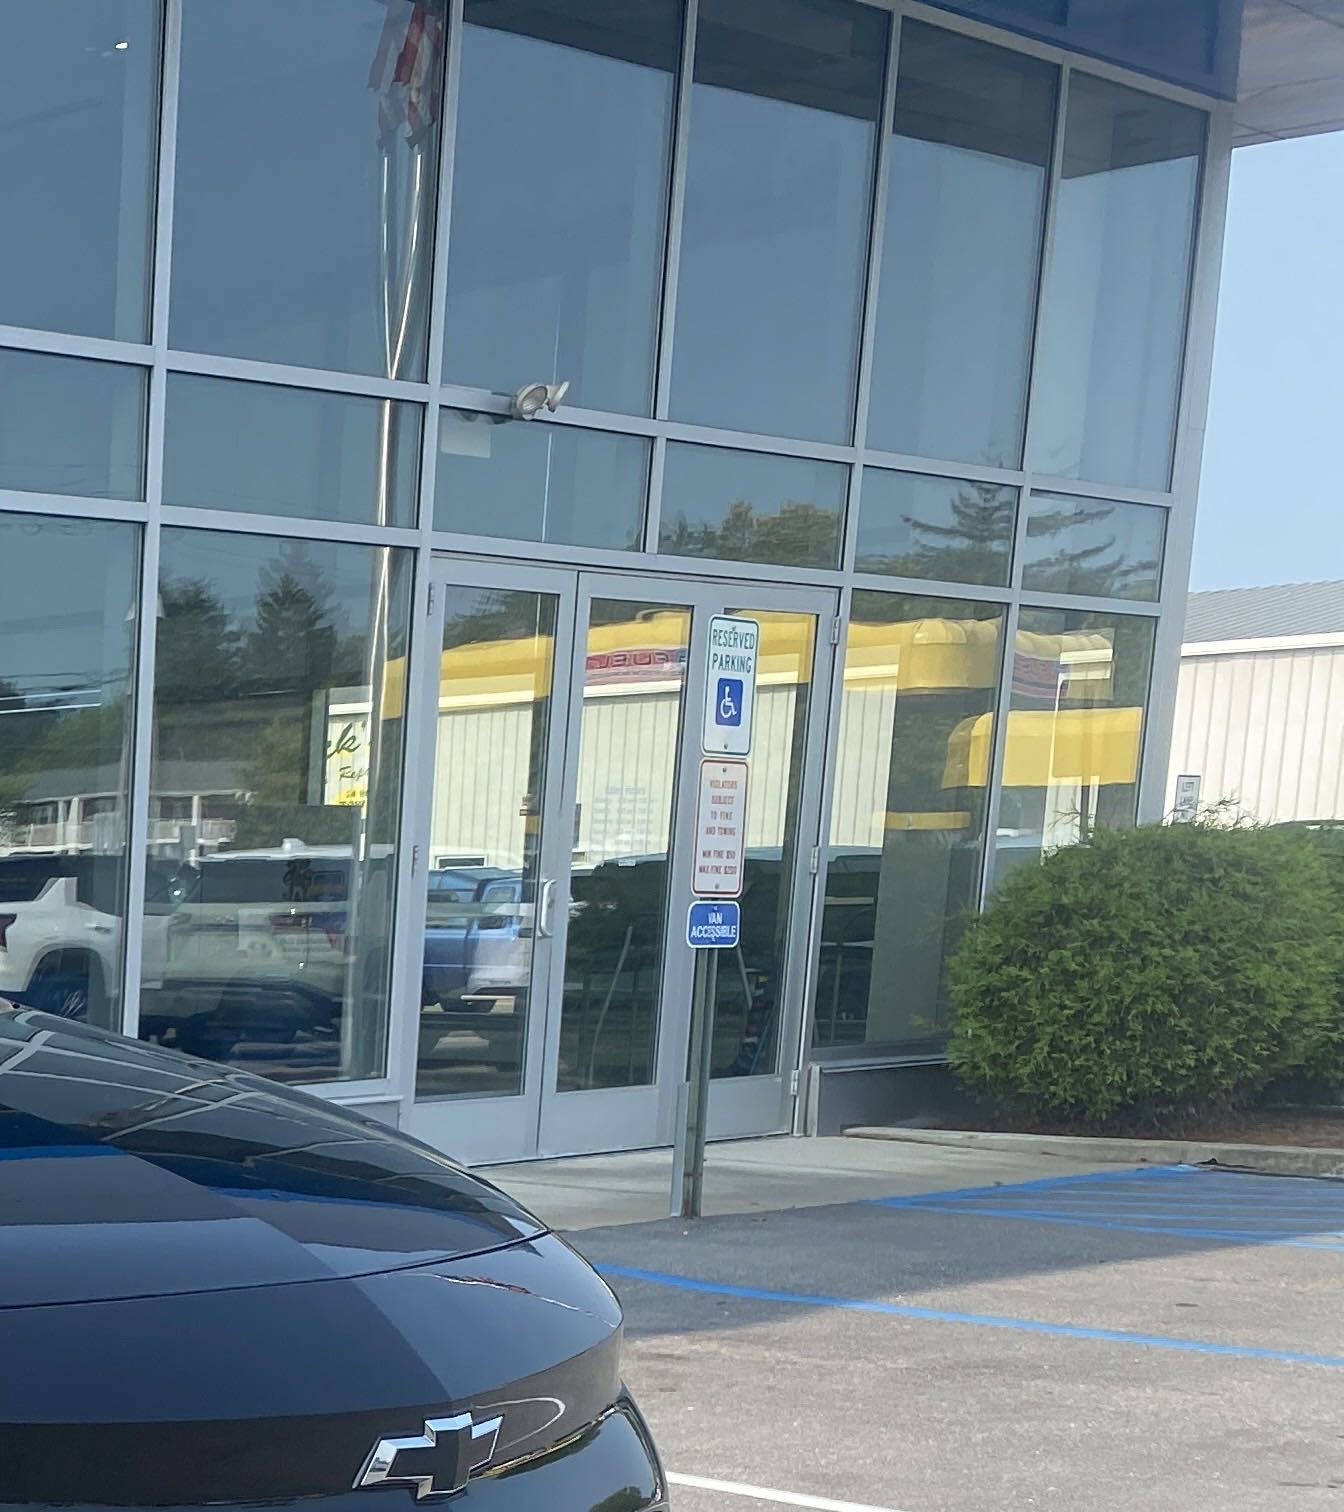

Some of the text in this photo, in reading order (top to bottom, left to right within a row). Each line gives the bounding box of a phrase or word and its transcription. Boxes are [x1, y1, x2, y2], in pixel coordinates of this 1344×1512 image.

[712, 629, 755, 650] RESERVED
[712, 653, 752, 674] PARKING
[708, 912, 722, 924] VAN
[690, 925, 736, 938] ACCESSIBLE
